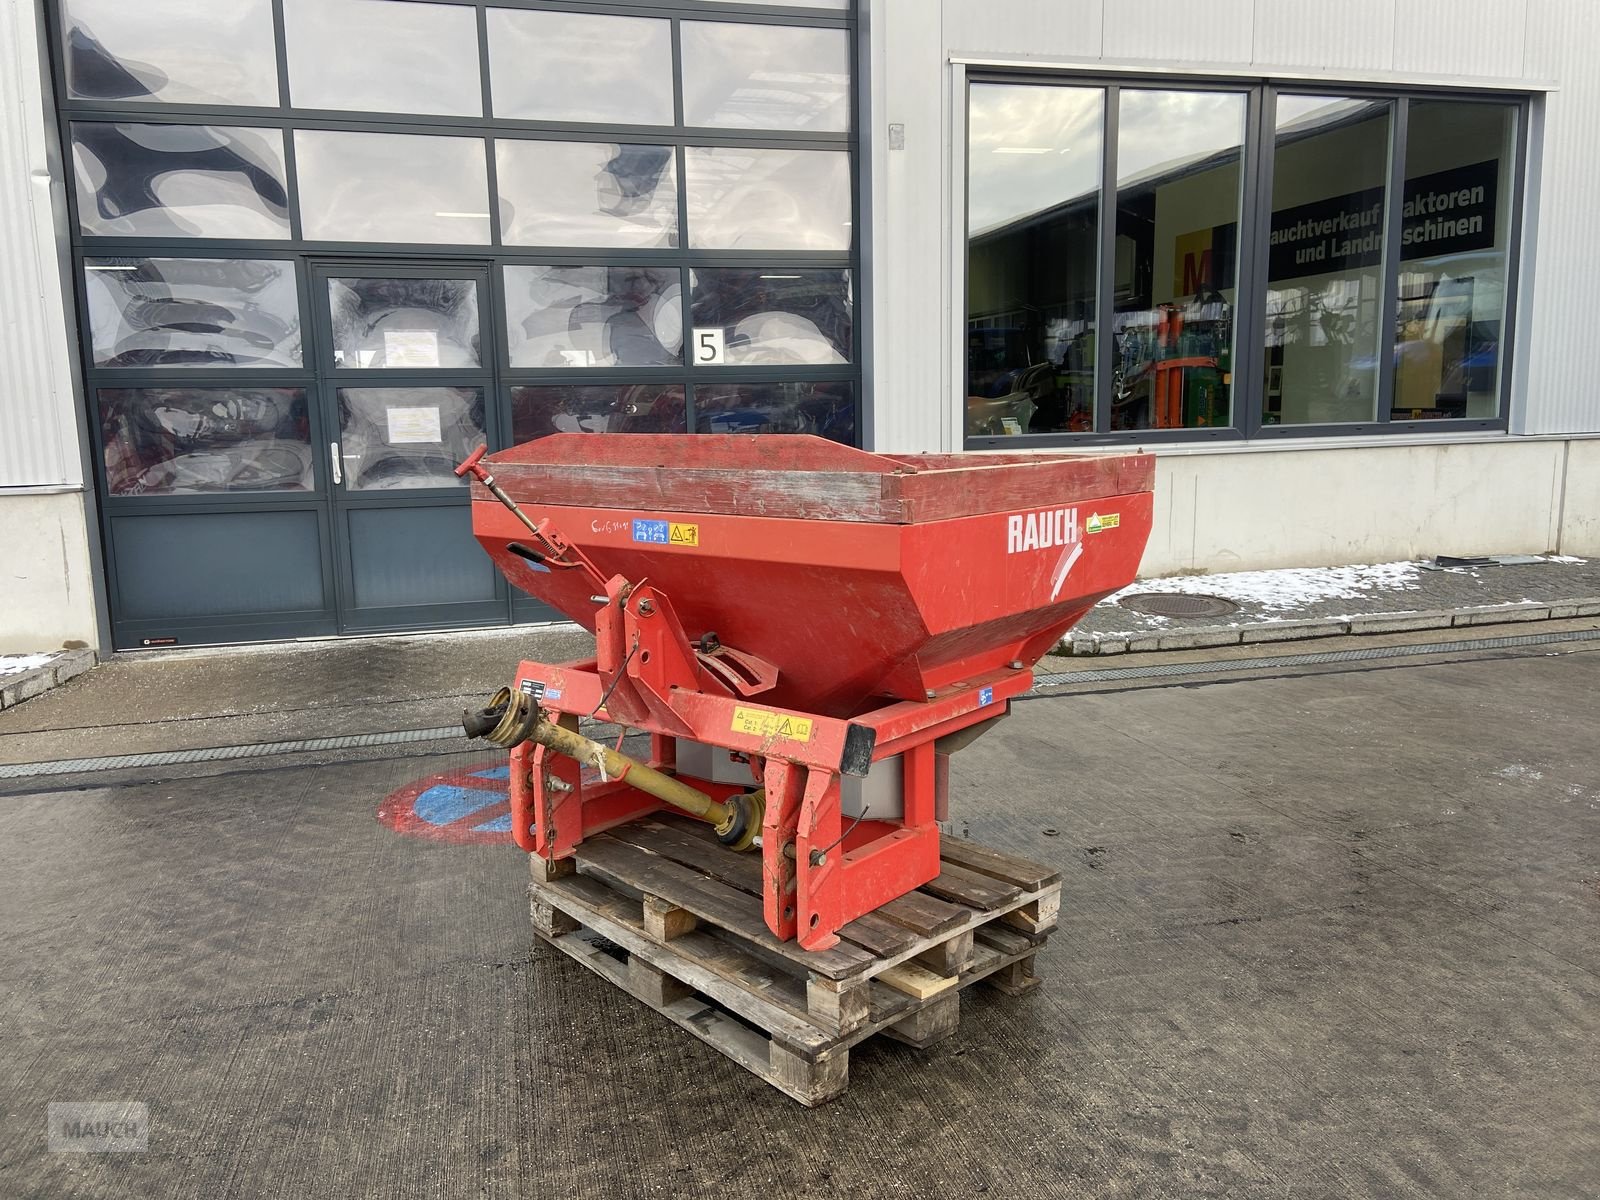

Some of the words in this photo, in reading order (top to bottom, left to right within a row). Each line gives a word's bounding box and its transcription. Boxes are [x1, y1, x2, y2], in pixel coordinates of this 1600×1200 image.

[1270, 203, 1381, 245] auchtverkauf
[1403, 185, 1484, 218] aktoren
[1295, 241, 1326, 264] und
[700, 333, 717, 361] 5
[1008, 507, 1078, 554] RAUCH
